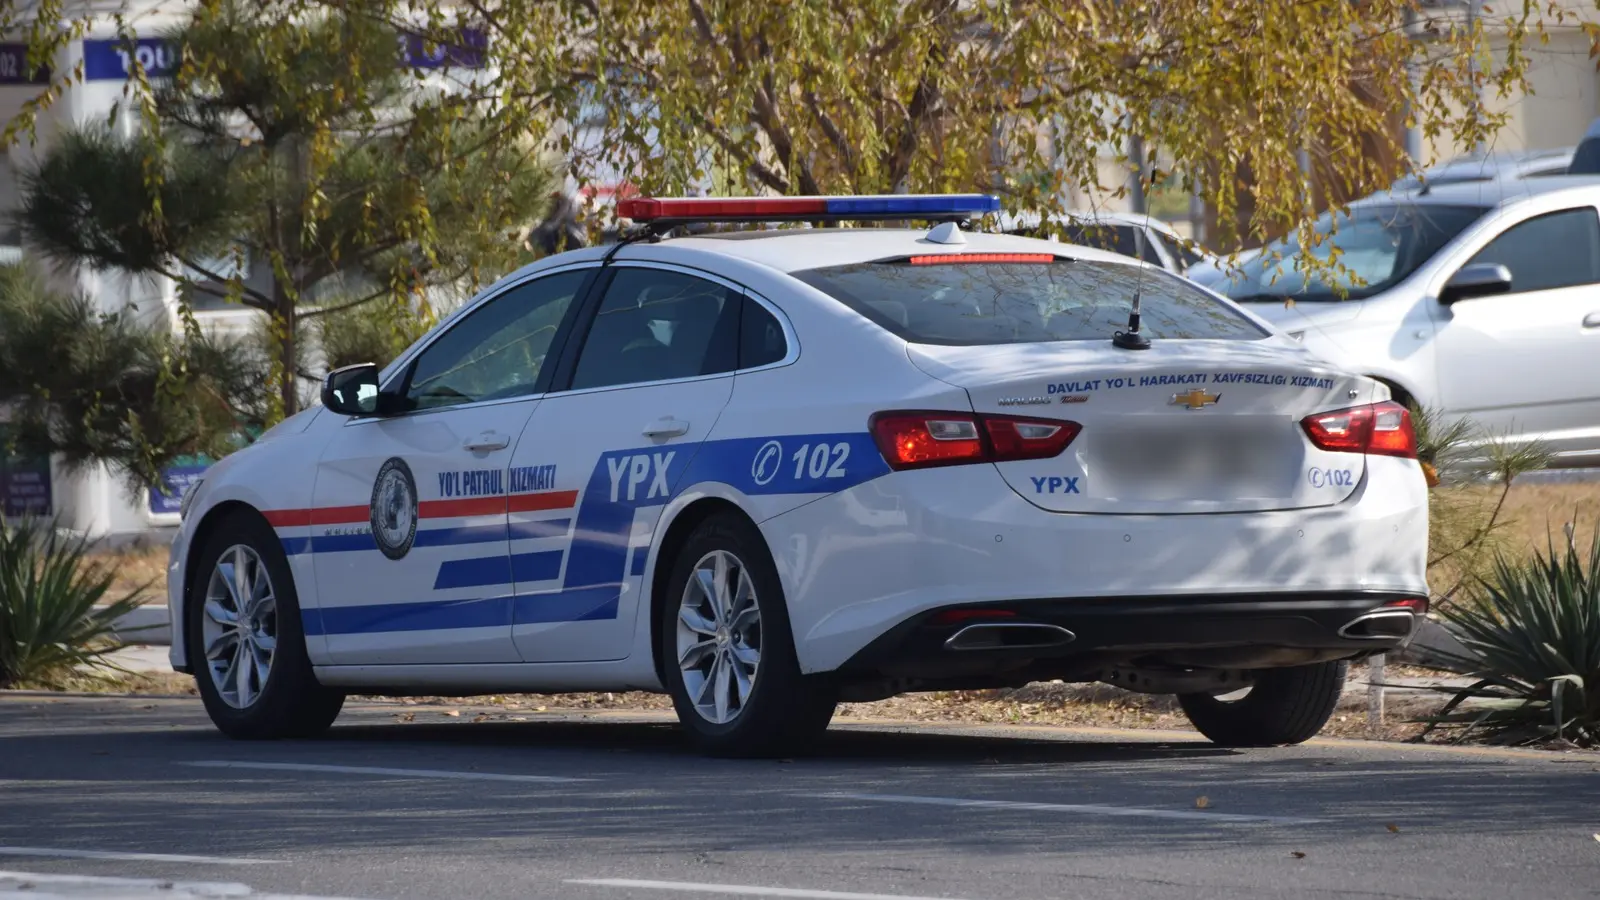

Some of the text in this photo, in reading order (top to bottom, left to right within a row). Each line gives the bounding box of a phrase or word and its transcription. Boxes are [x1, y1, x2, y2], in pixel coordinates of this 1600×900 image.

[1047, 380, 1101, 394] DAVLAT
[1139, 373, 1207, 387] HARAKATI
[1290, 376, 1334, 390] XIZMATI
[792, 442, 850, 480] 102
[438, 464, 557, 497] YO'L PATRUL XIZMATI
[607, 451, 676, 503] YPX
[1029, 476, 1080, 494] YPX
[1325, 469, 1353, 486] 102
